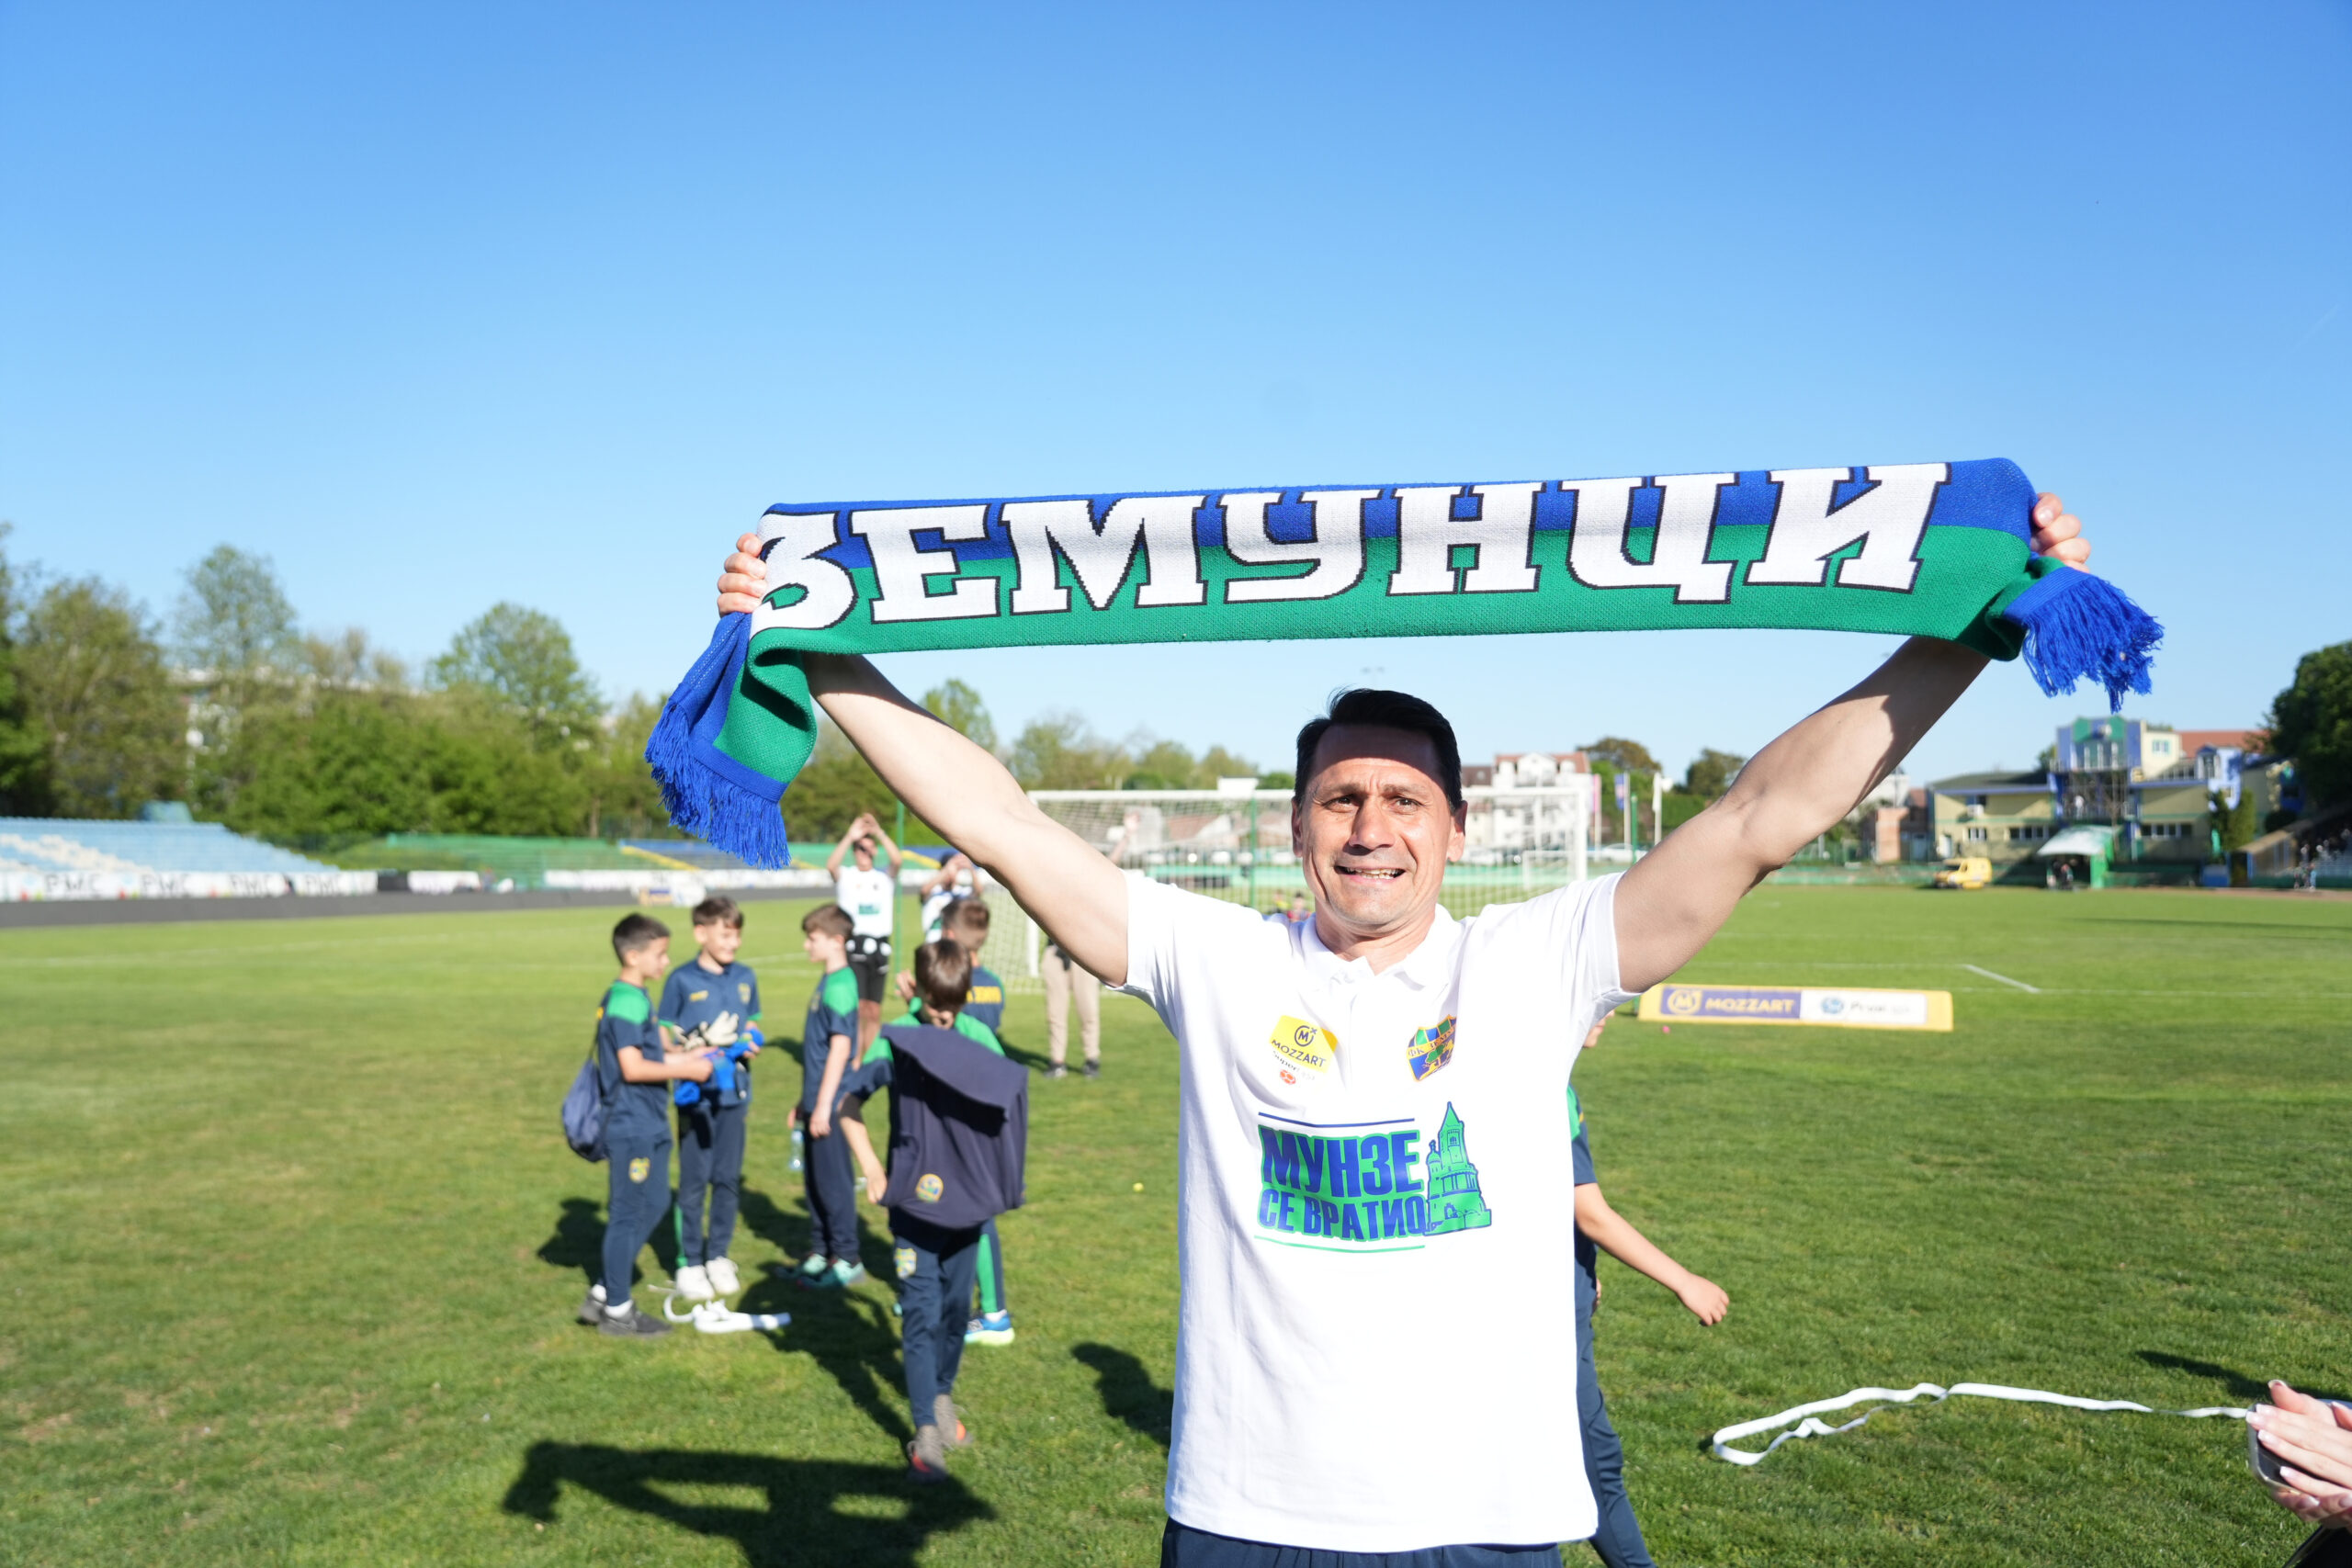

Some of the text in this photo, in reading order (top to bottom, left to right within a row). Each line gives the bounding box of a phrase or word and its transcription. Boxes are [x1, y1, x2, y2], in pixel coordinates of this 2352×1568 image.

[748, 462, 1950, 640] ЗЕМУНЦИ
[1705, 998, 1795, 1013] MOZZART
[1272, 1039, 1327, 1067] MOZZART
[1259, 1125, 1423, 1198] МУНЗЕ
[1258, 1189, 1429, 1240] СЕ ВРАТИО
